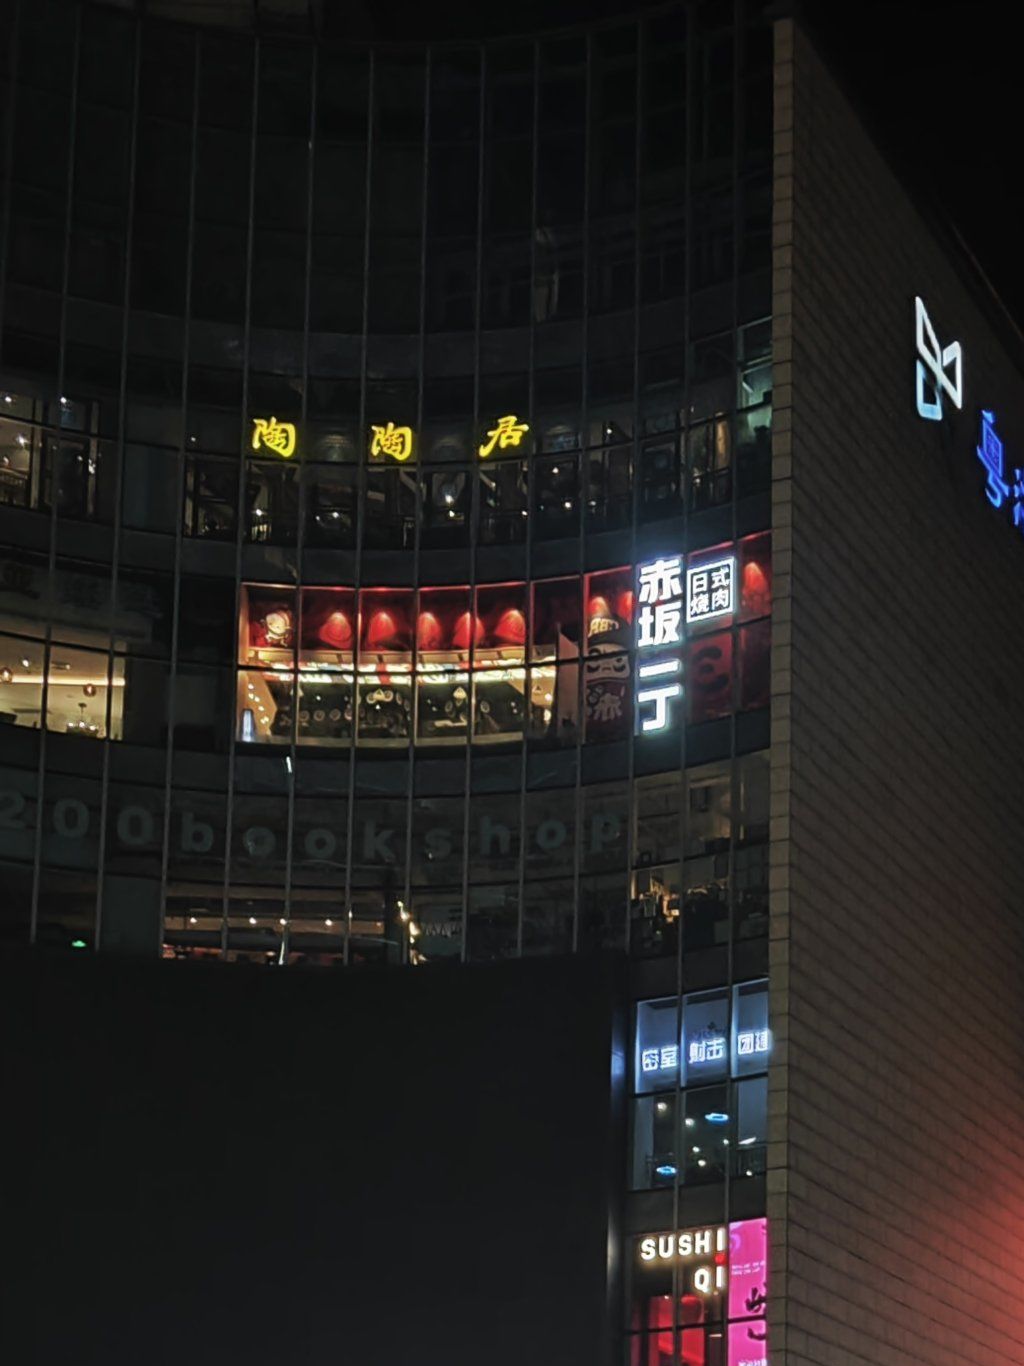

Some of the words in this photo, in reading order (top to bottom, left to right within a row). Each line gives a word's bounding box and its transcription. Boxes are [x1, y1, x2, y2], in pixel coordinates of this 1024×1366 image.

[252, 416, 529, 460] 陶陶居
[638, 558, 683, 731] 赤坂一丁
[640, 1227, 726, 1261] SUSHI
[694, 1265, 725, 1293] QI
